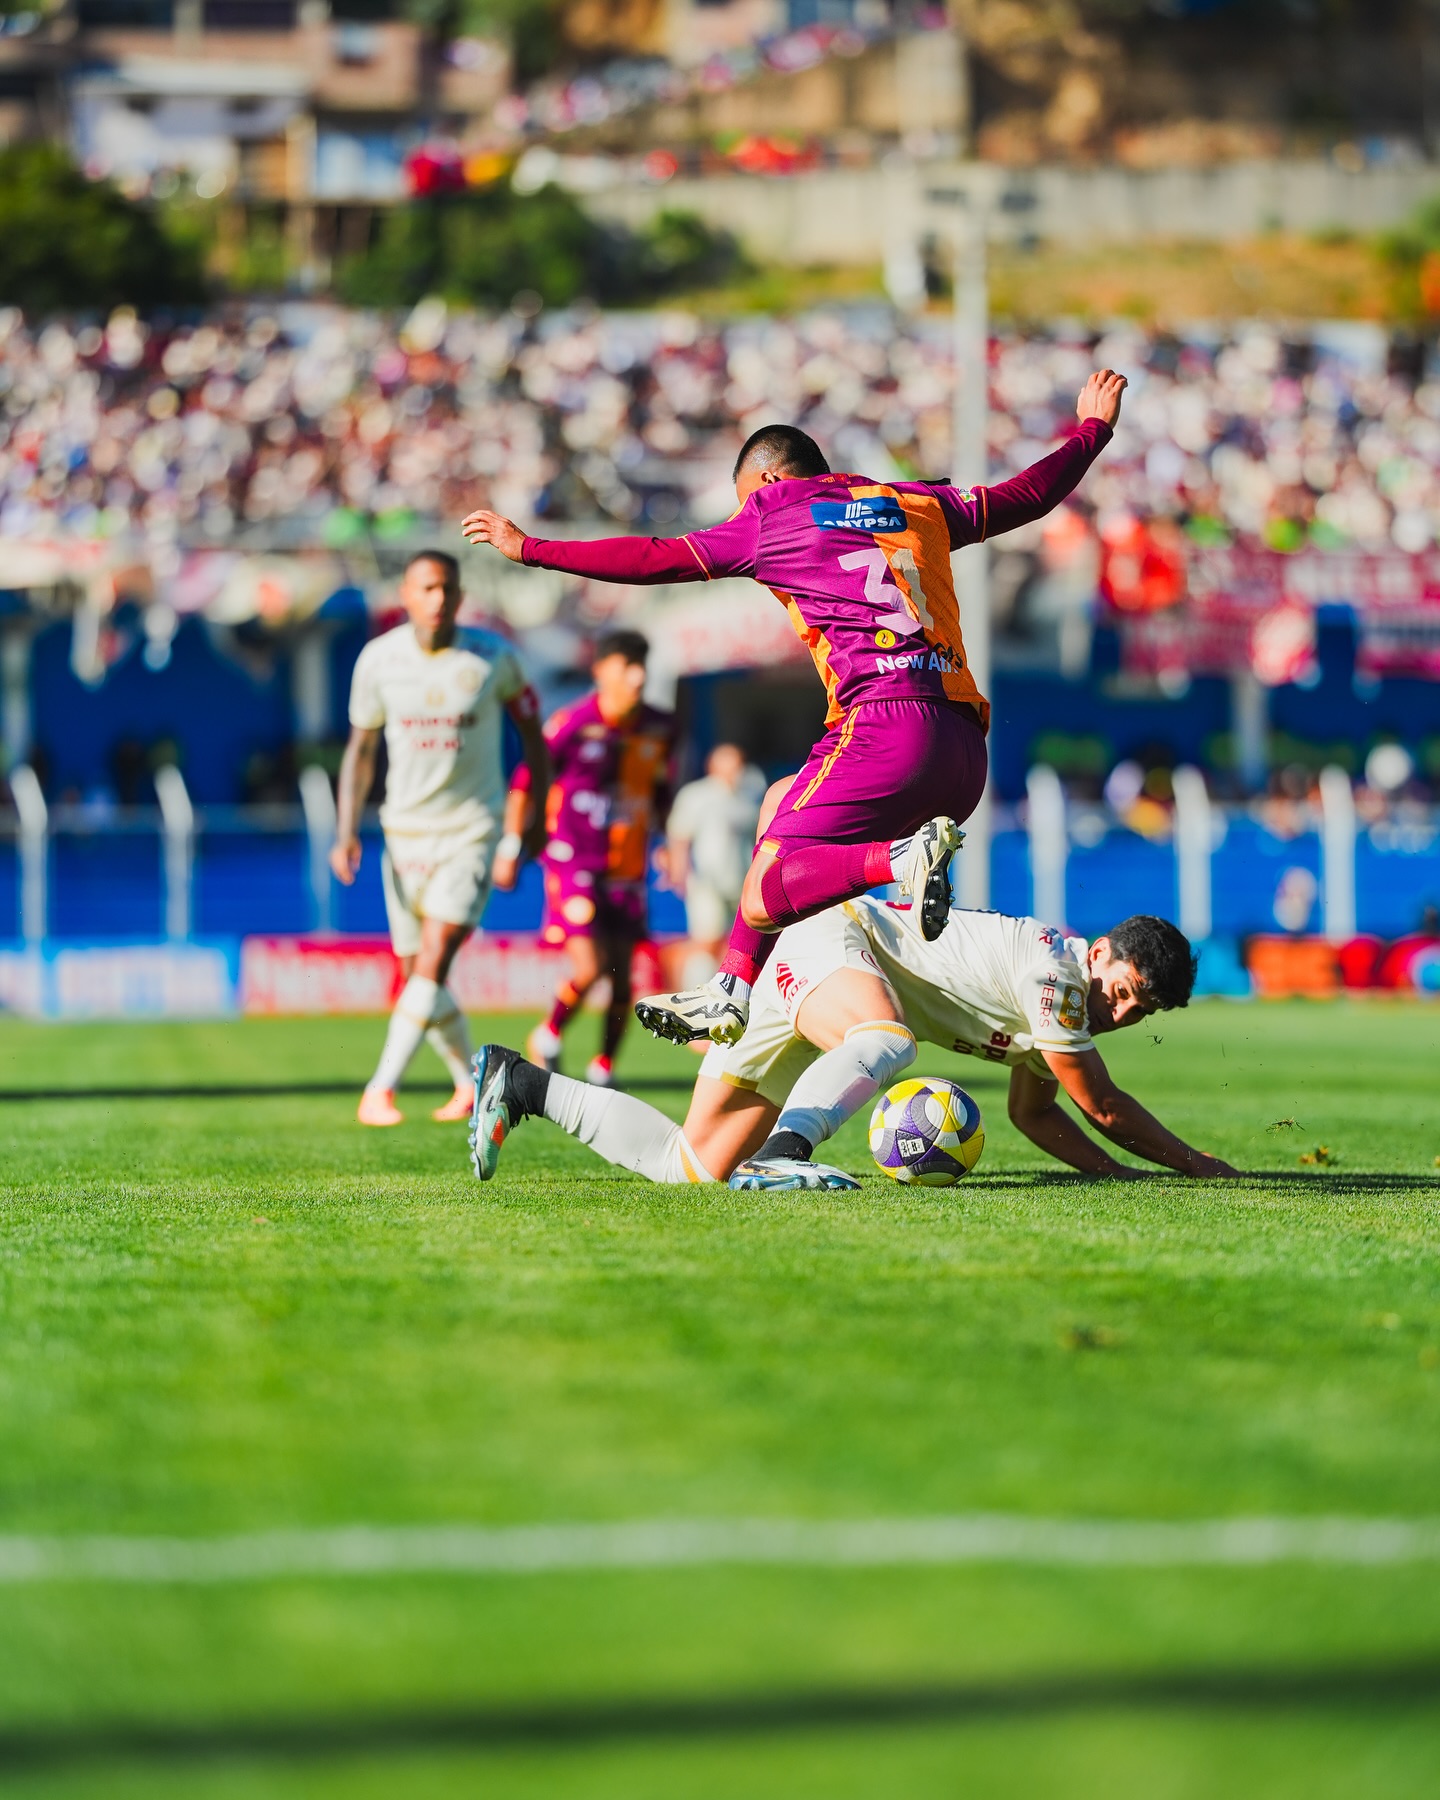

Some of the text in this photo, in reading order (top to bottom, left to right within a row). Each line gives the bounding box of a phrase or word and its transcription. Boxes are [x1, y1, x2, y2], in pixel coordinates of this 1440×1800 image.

[837, 547, 934, 636] 31
[875, 655, 925, 674] New
[981, 1031, 1012, 1063] ap
